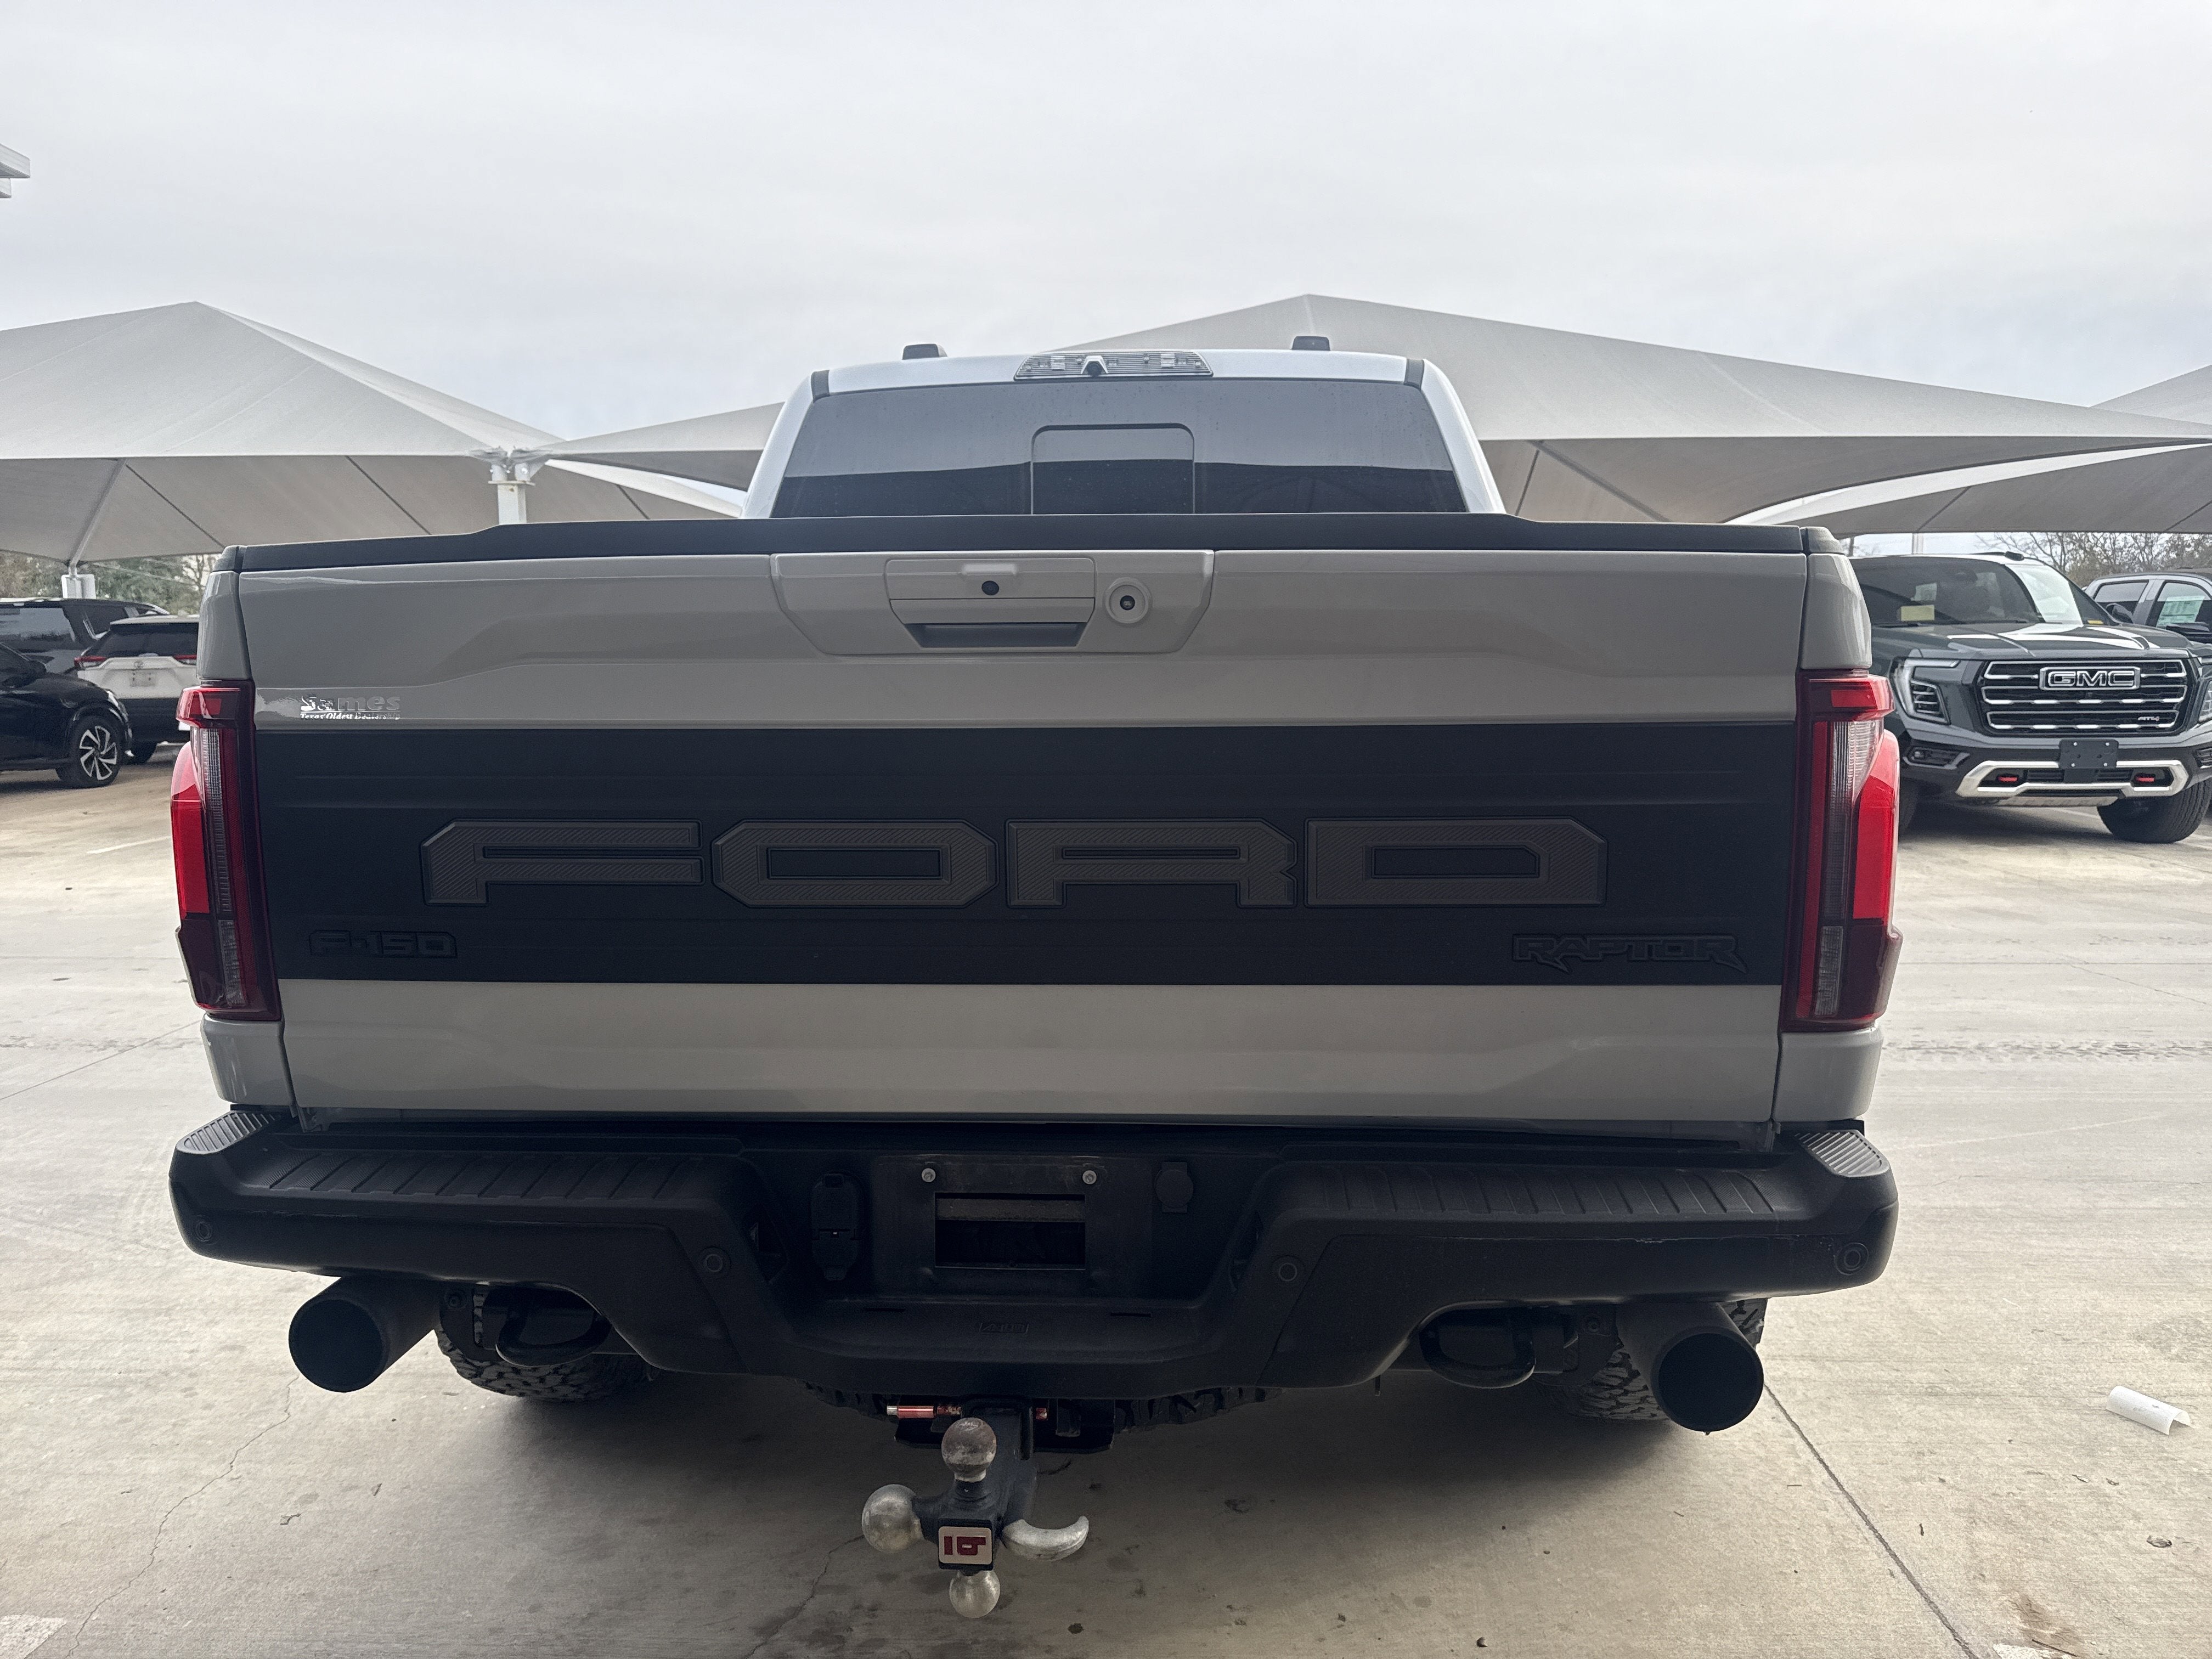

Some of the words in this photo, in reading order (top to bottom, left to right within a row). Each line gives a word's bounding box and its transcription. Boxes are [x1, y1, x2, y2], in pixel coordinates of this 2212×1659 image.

[2048, 670, 2135, 686] GMC
[301, 694, 401, 711] Sames
[421, 819, 1607, 909] FORD
[309, 930, 457, 958] F-150
[1513, 934, 1749, 974] RAPTOR
